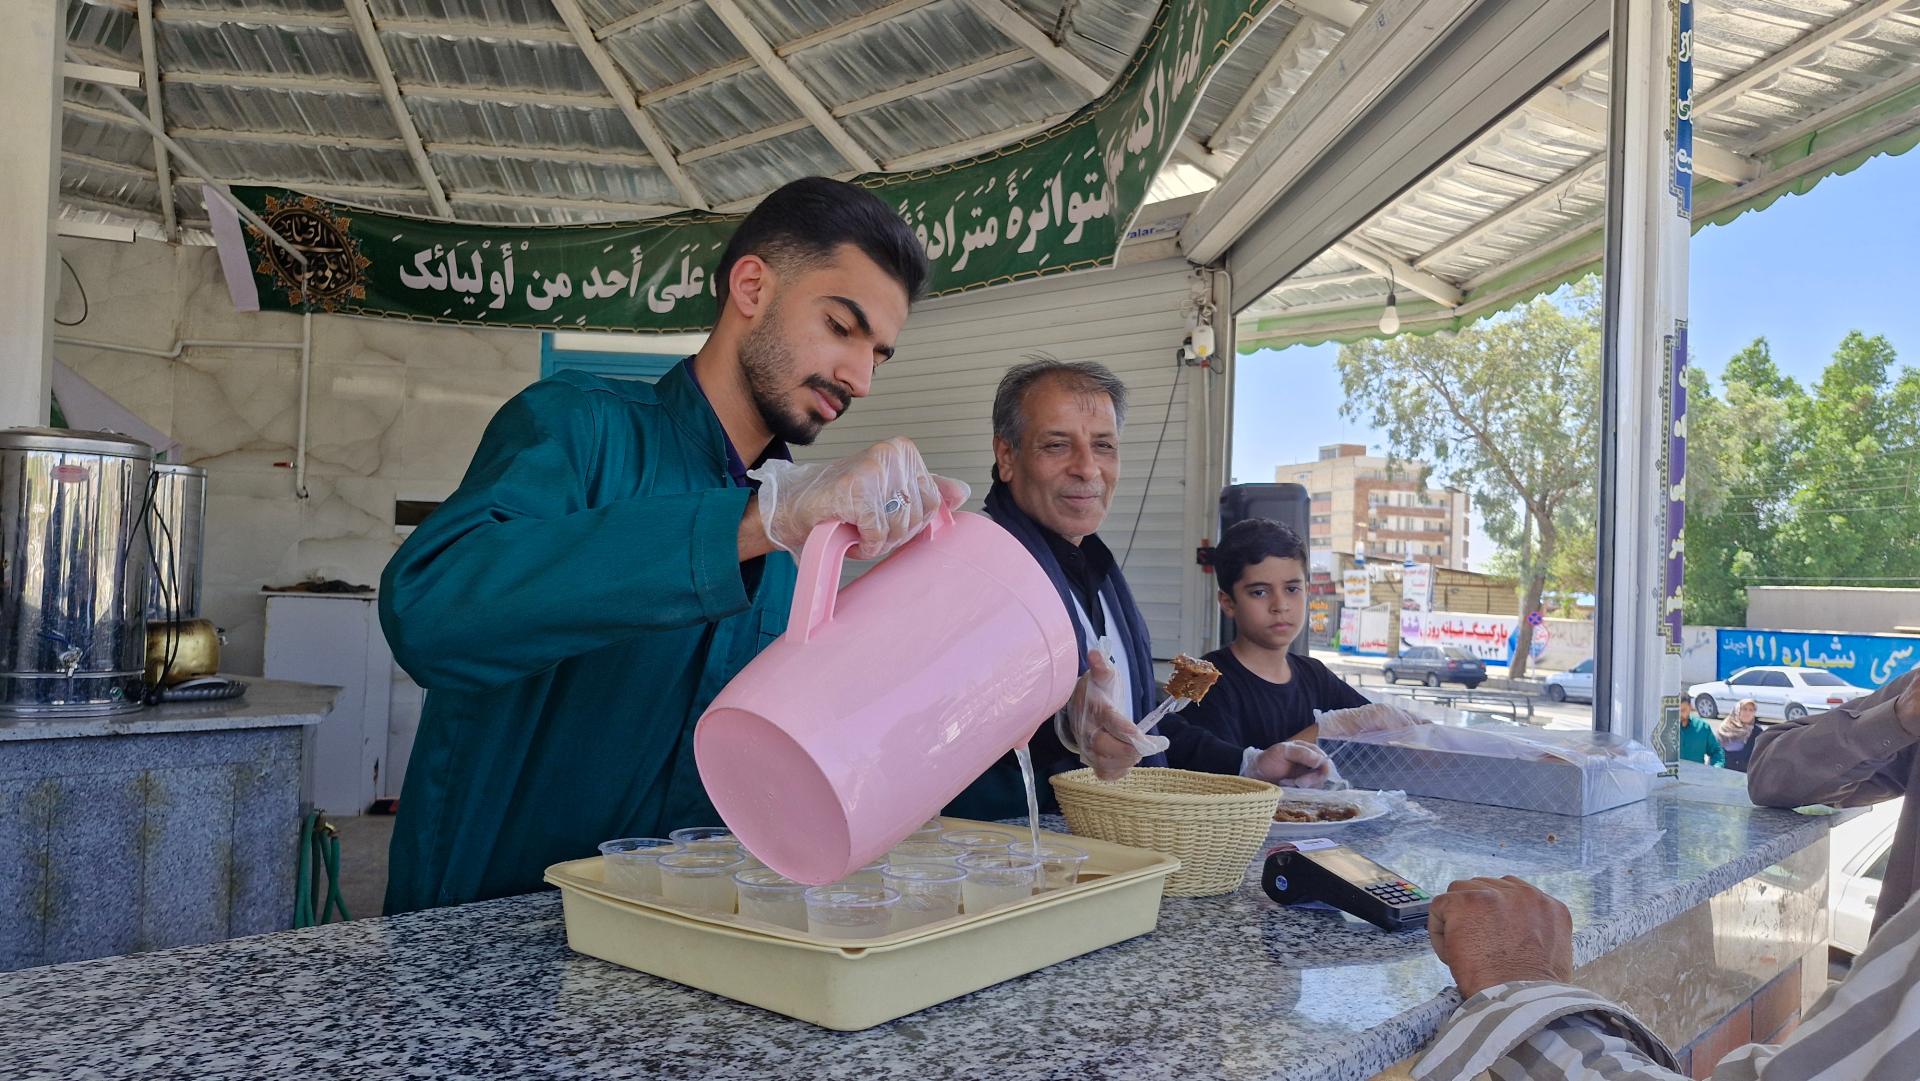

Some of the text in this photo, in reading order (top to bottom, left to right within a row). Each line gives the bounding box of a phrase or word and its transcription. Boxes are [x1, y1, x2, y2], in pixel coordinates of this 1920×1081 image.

[1441, 620, 1464, 638] شبانه
[1466, 621, 1508, 647] پارکینگ
[1746, 635, 1776, 662] ۱۹۱
[1782, 636, 1856, 668] شماره
